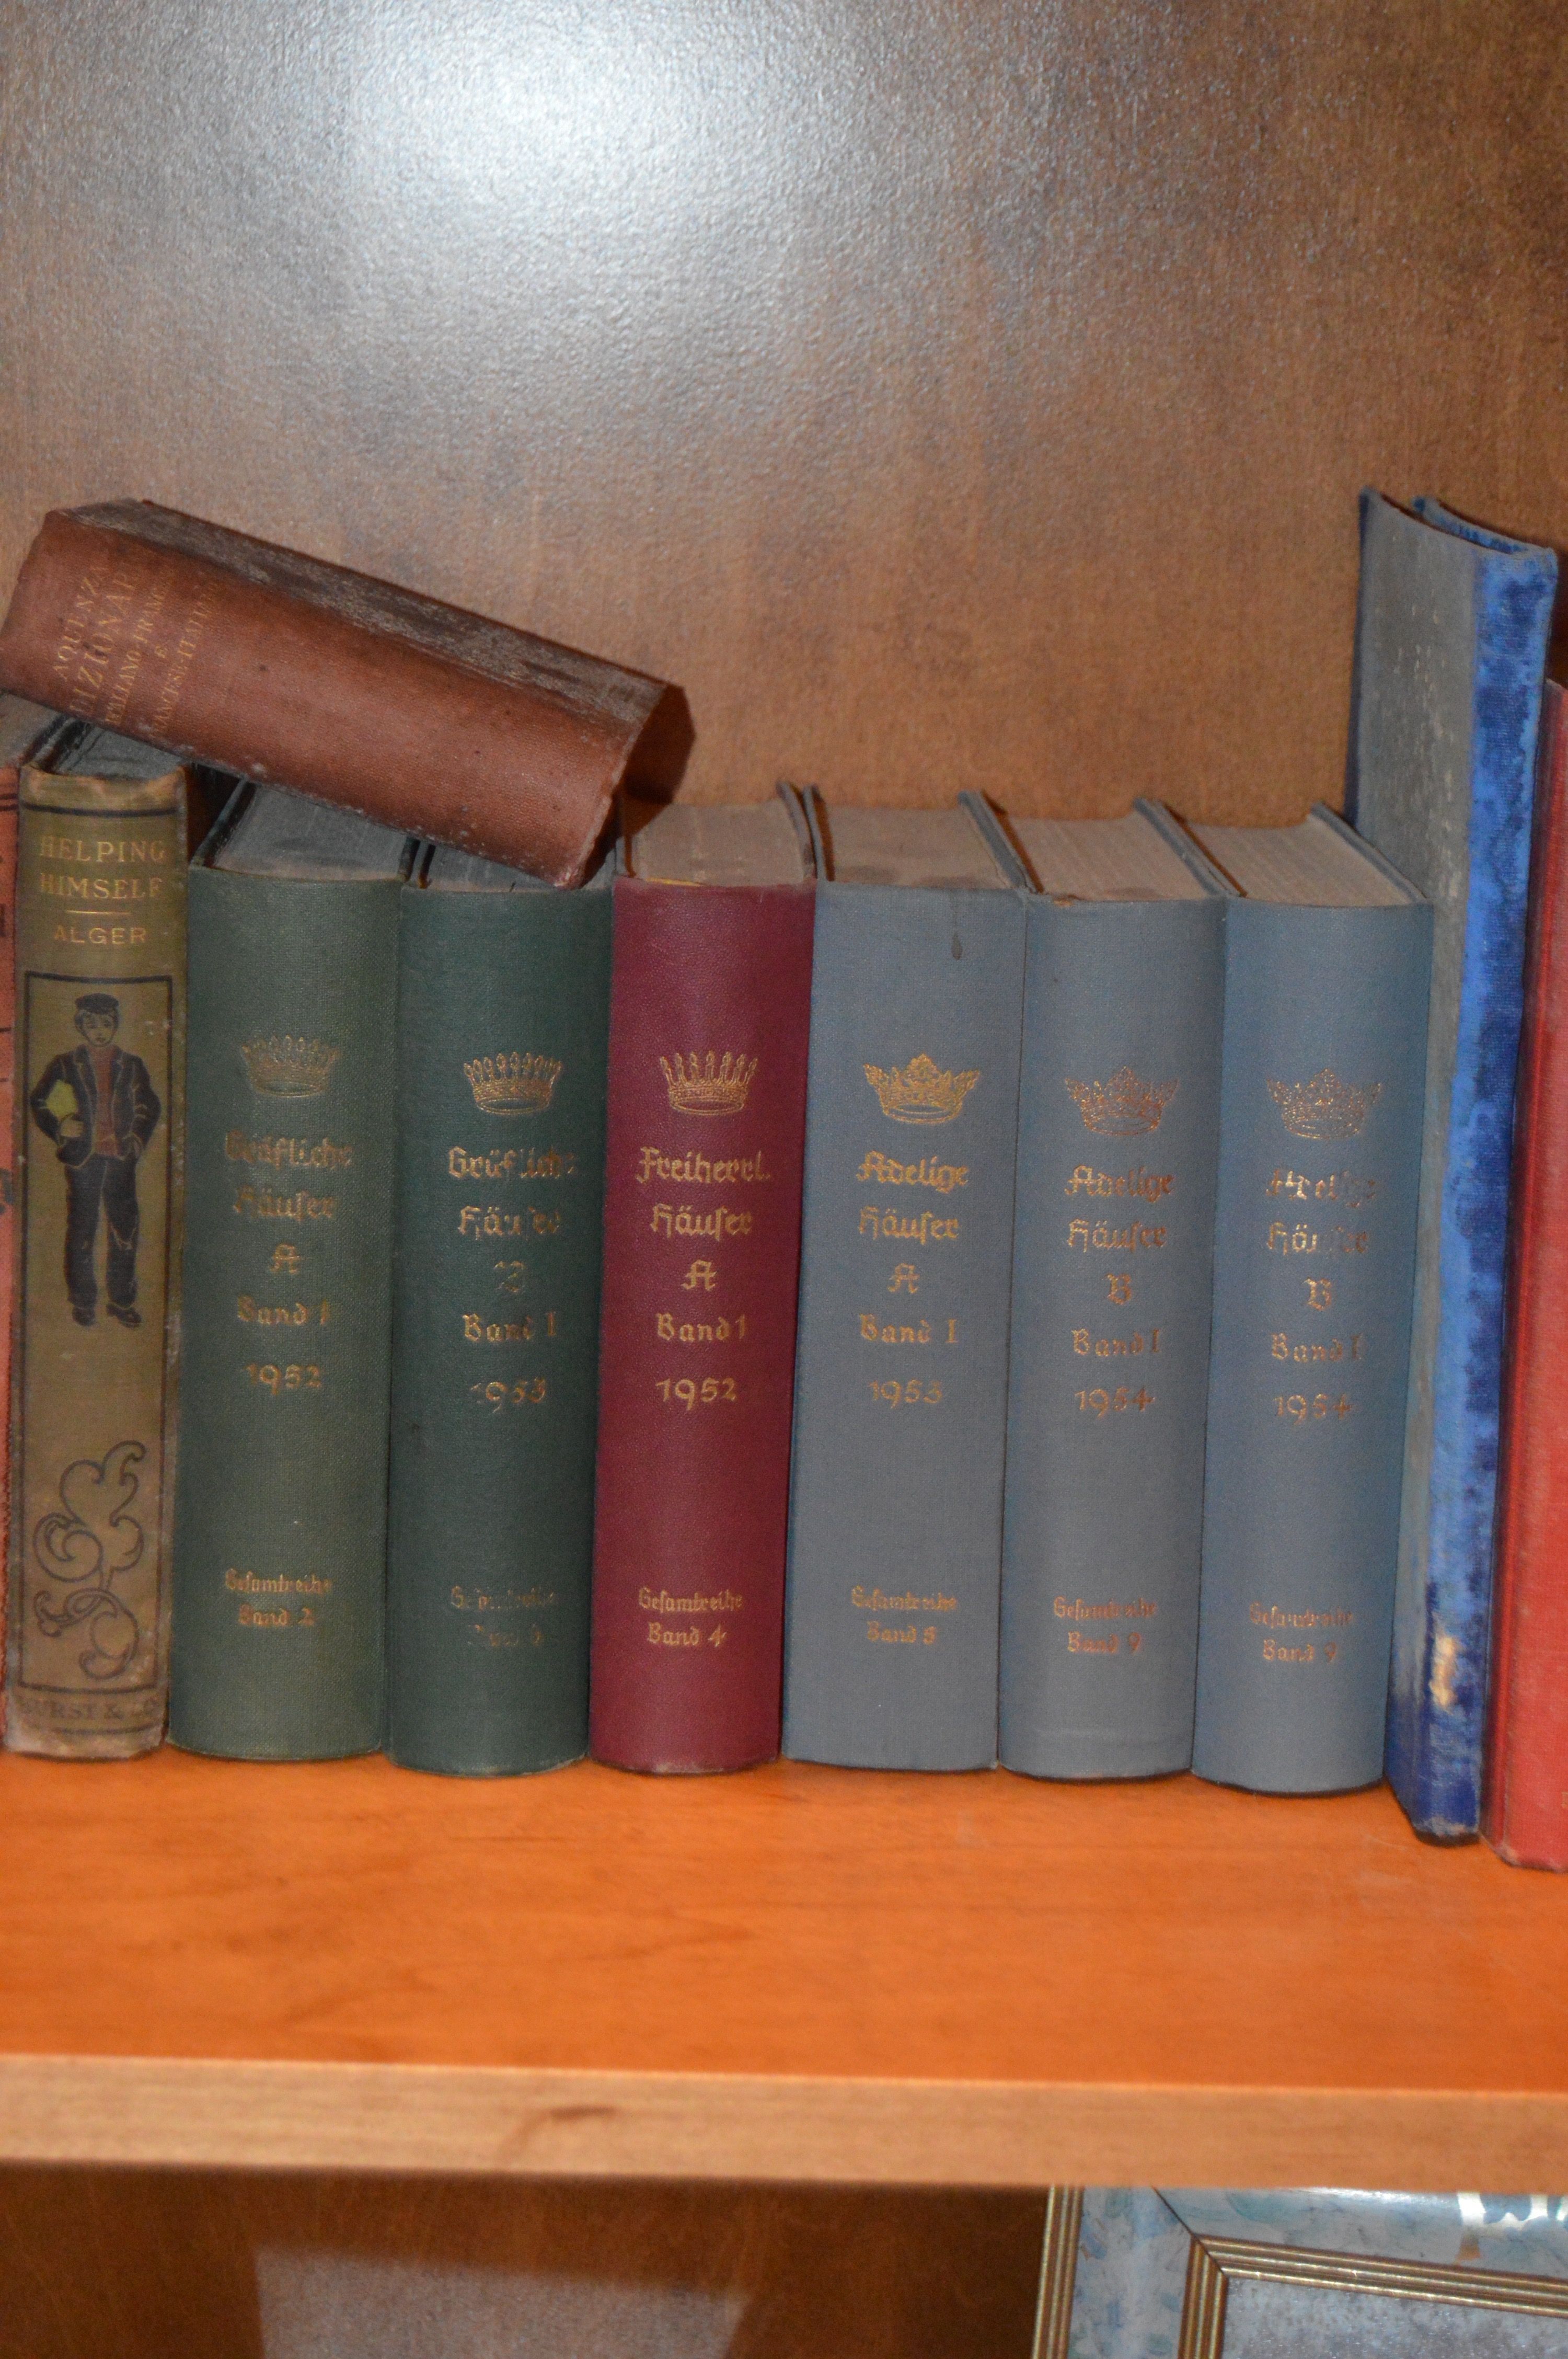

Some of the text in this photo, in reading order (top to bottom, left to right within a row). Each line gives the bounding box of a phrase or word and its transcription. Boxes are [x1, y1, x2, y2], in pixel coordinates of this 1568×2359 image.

[39, 835, 165, 862] HELPING
[40, 872, 163, 899] HIMSELF
[54, 925, 147, 944] ALGER
[856, 1150, 968, 1193] Adelige
[1064, 1164, 1174, 1203] Adelige
[269, 1244, 299, 1274] A
[681, 1259, 717, 1290] A
[889, 1263, 920, 1293] A
[1102, 1273, 1132, 1305] B
[1302, 1278, 1331, 1310] B
[656, 1312, 730, 1342] Band
[860, 1313, 931, 1343] Band
[1071, 1329, 1144, 1356] Band
[1271, 1333, 1343, 1362] Band
[243, 1362, 321, 1395] 1952
[656, 1377, 738, 1411] 1952
[1075, 1387, 1156, 1419] 1954
[1273, 1393, 1354, 1426] 1954
[648, 1621, 727, 1647] Band 4
[867, 1621, 917, 1643] Band
[1067, 1631, 1119, 1654] Band
[1263, 1639, 1315, 1662] Band
